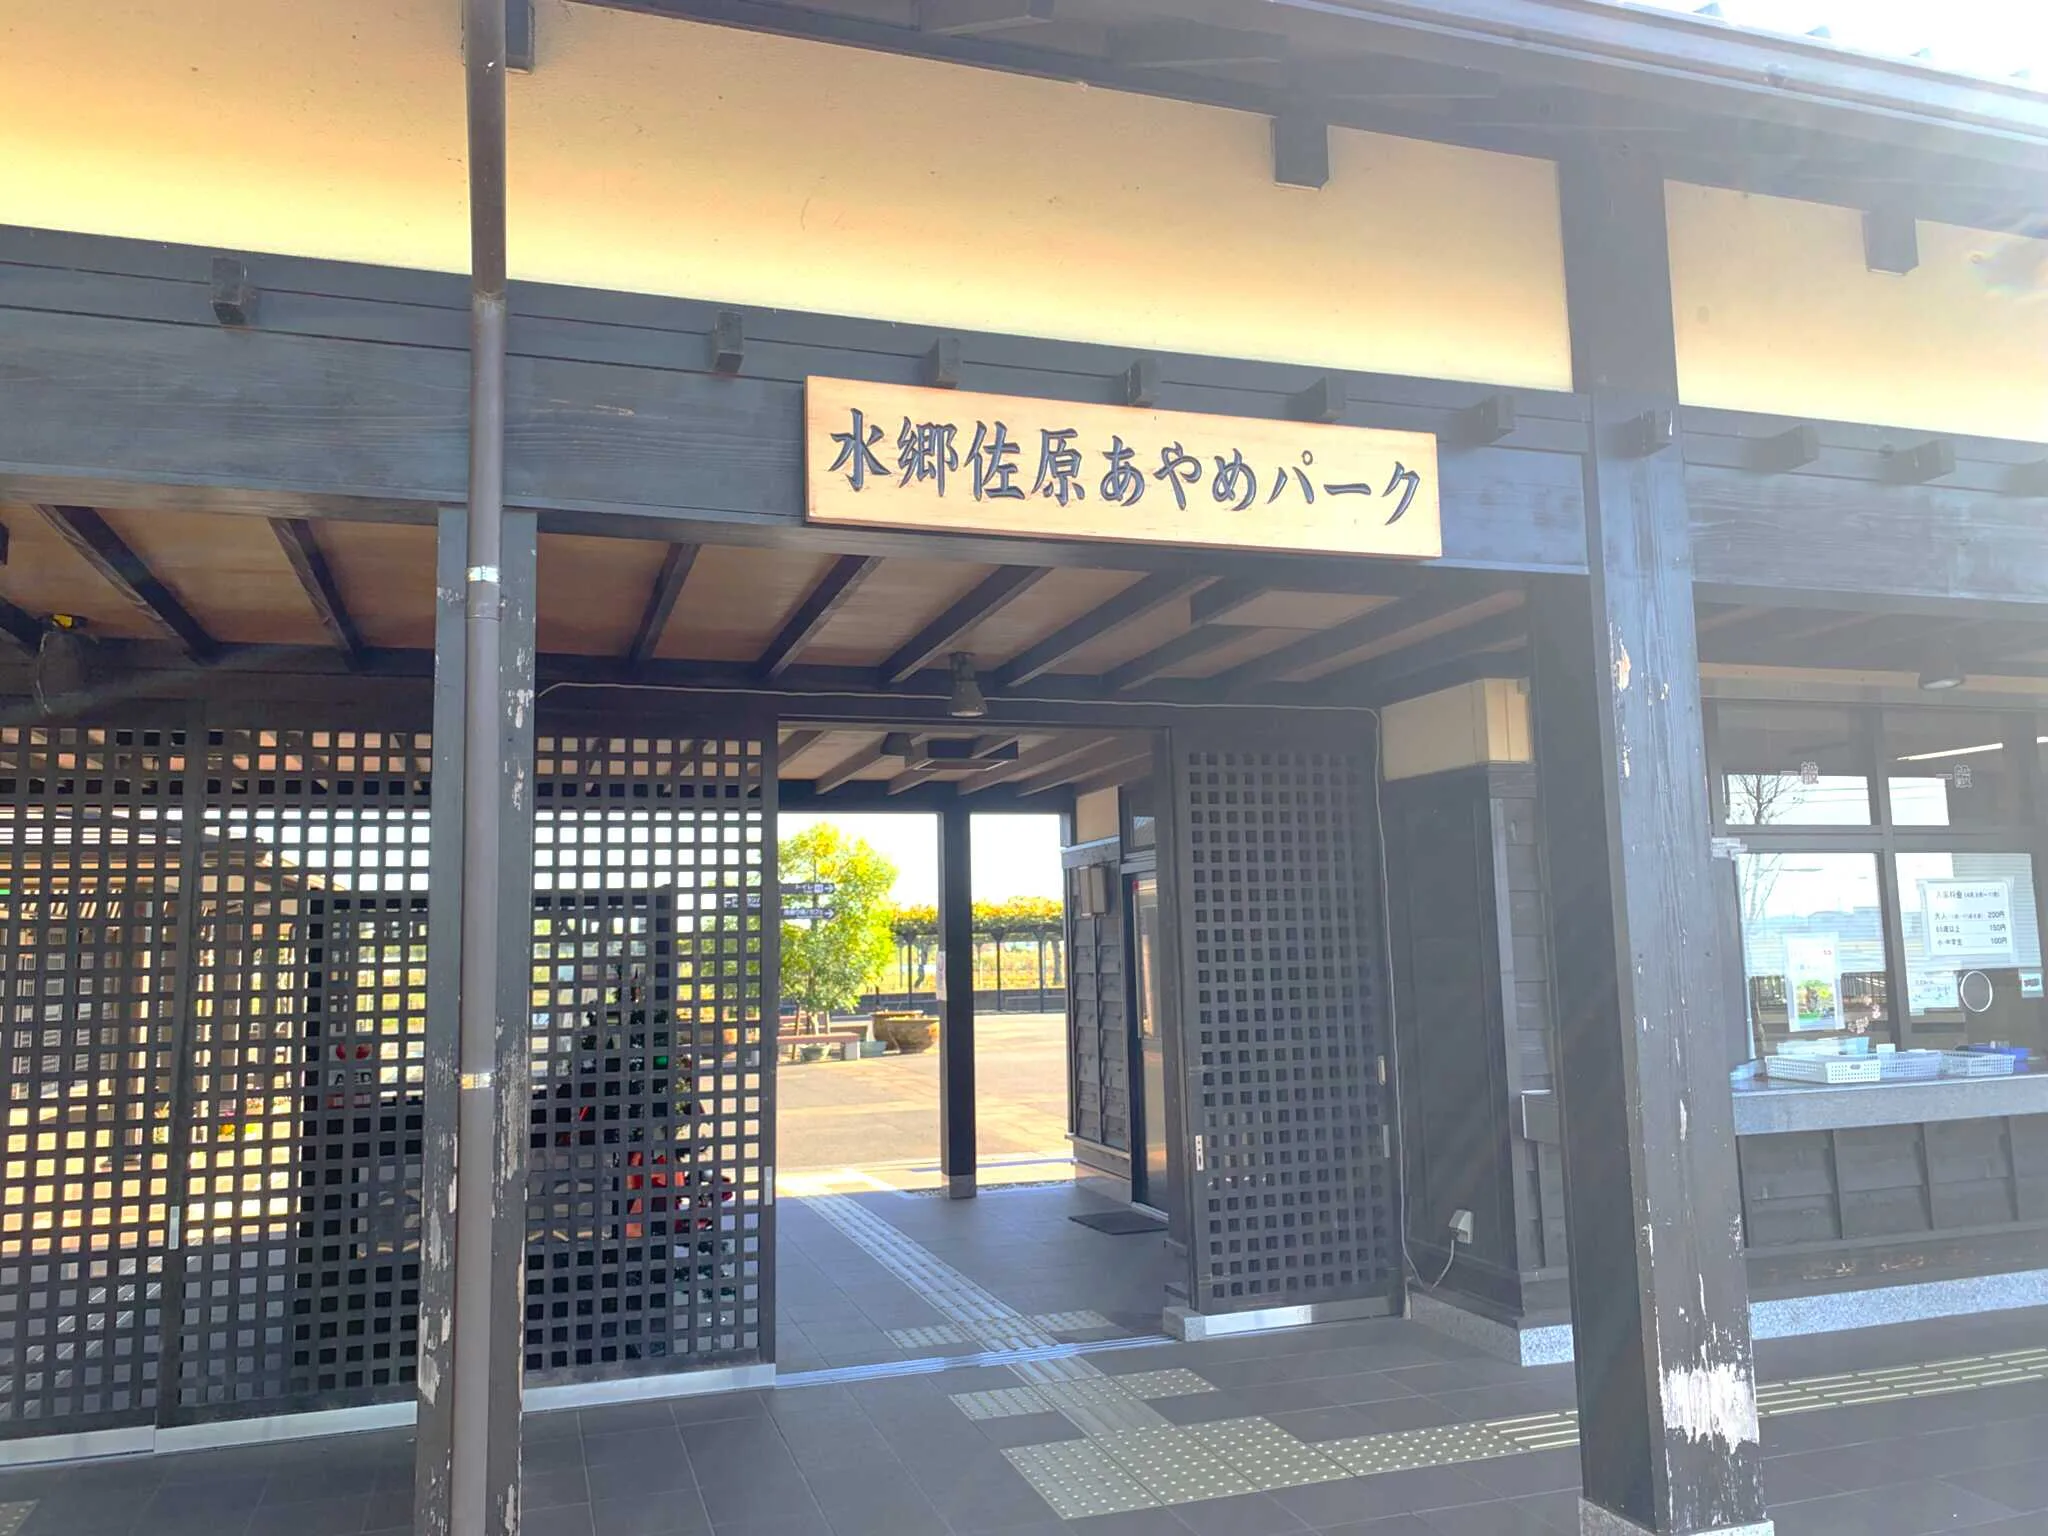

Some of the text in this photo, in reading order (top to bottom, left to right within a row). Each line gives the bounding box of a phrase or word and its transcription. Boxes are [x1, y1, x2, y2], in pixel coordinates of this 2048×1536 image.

[829, 407, 1422, 526] 水郷佐原あやめパーク
[1780, 760, 1819, 785] 一般
[1935, 764, 1973, 788] 一般
[1987, 910, 2005, 919] 200円
[1989, 923, 2006, 932] 150円
[1990, 936, 2007, 945] 100円
